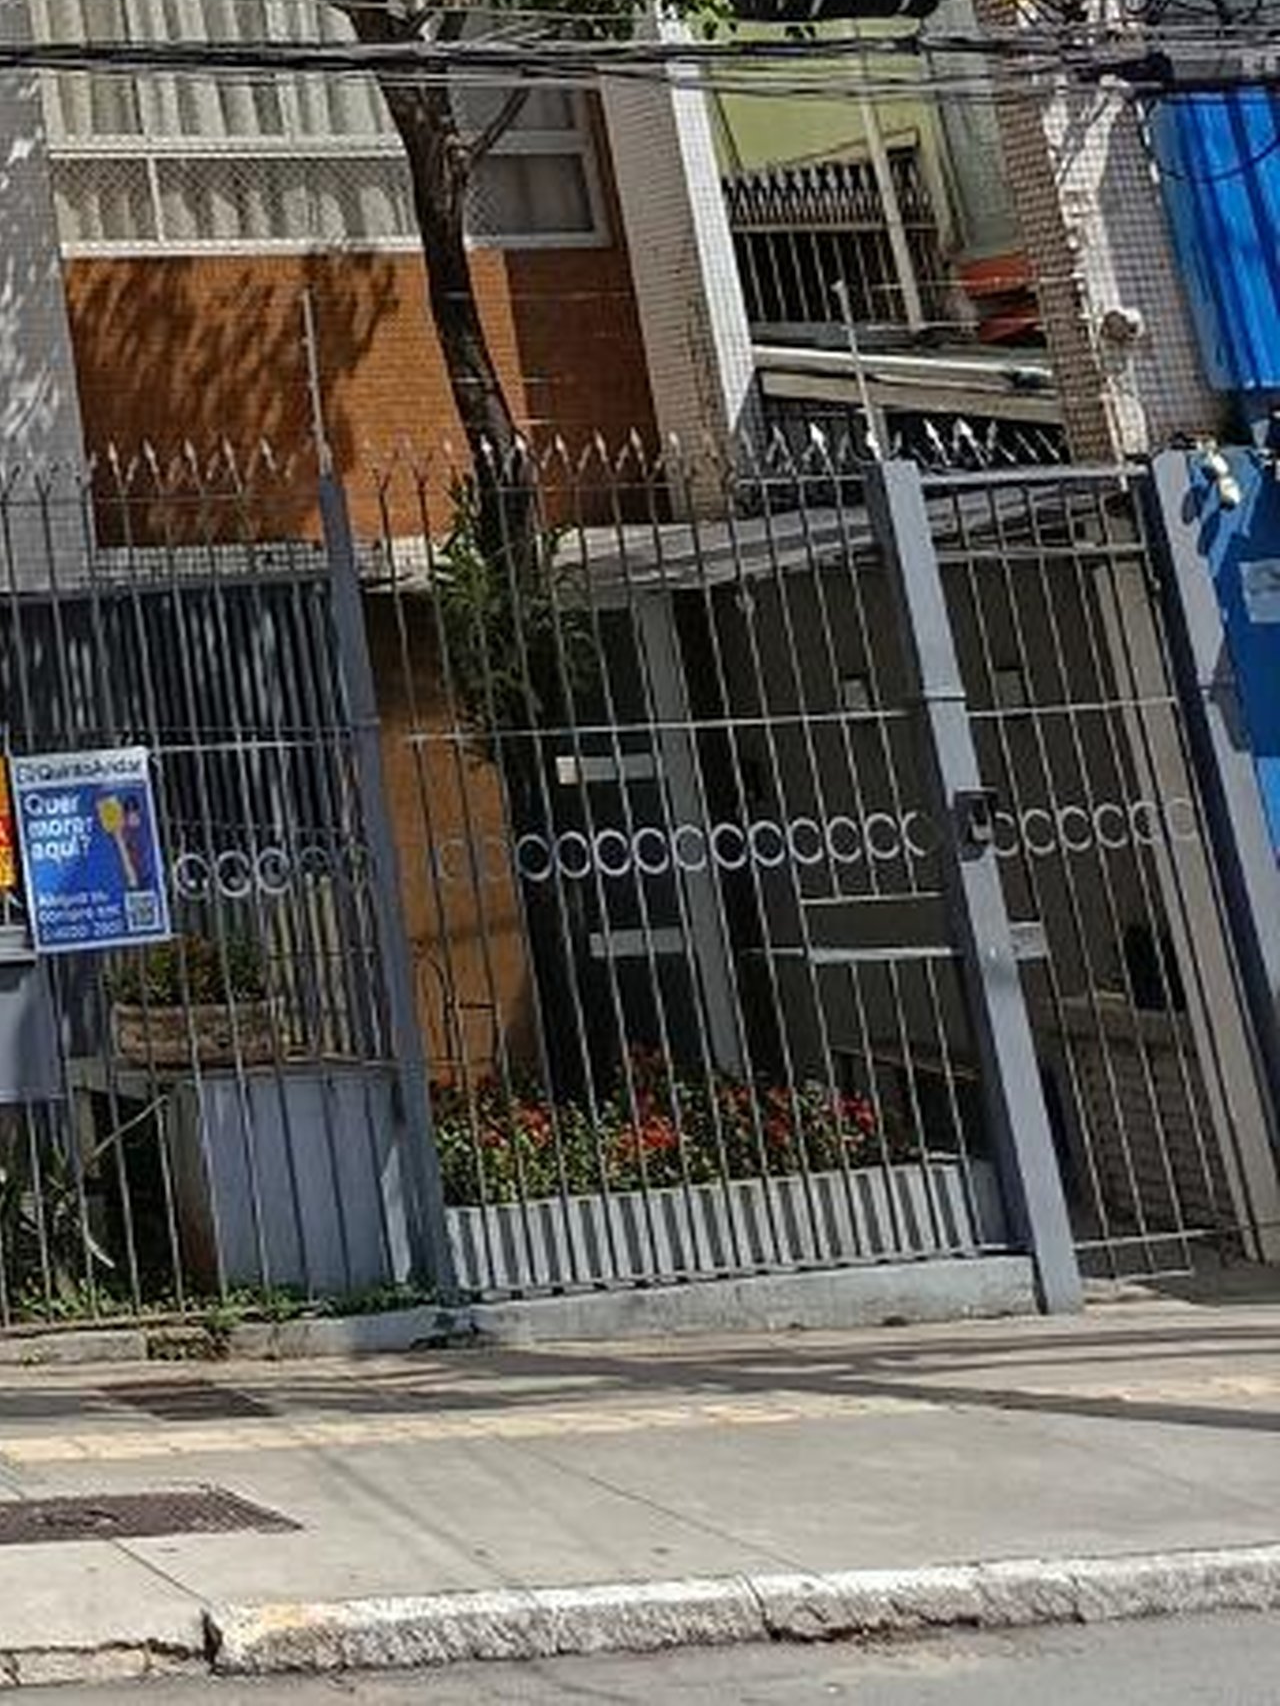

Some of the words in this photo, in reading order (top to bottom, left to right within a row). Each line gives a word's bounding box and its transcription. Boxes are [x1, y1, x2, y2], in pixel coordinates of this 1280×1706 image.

[24, 792, 81, 815] Quer
[27, 816, 93, 837] morar
[31, 835, 92, 864] aqui?
